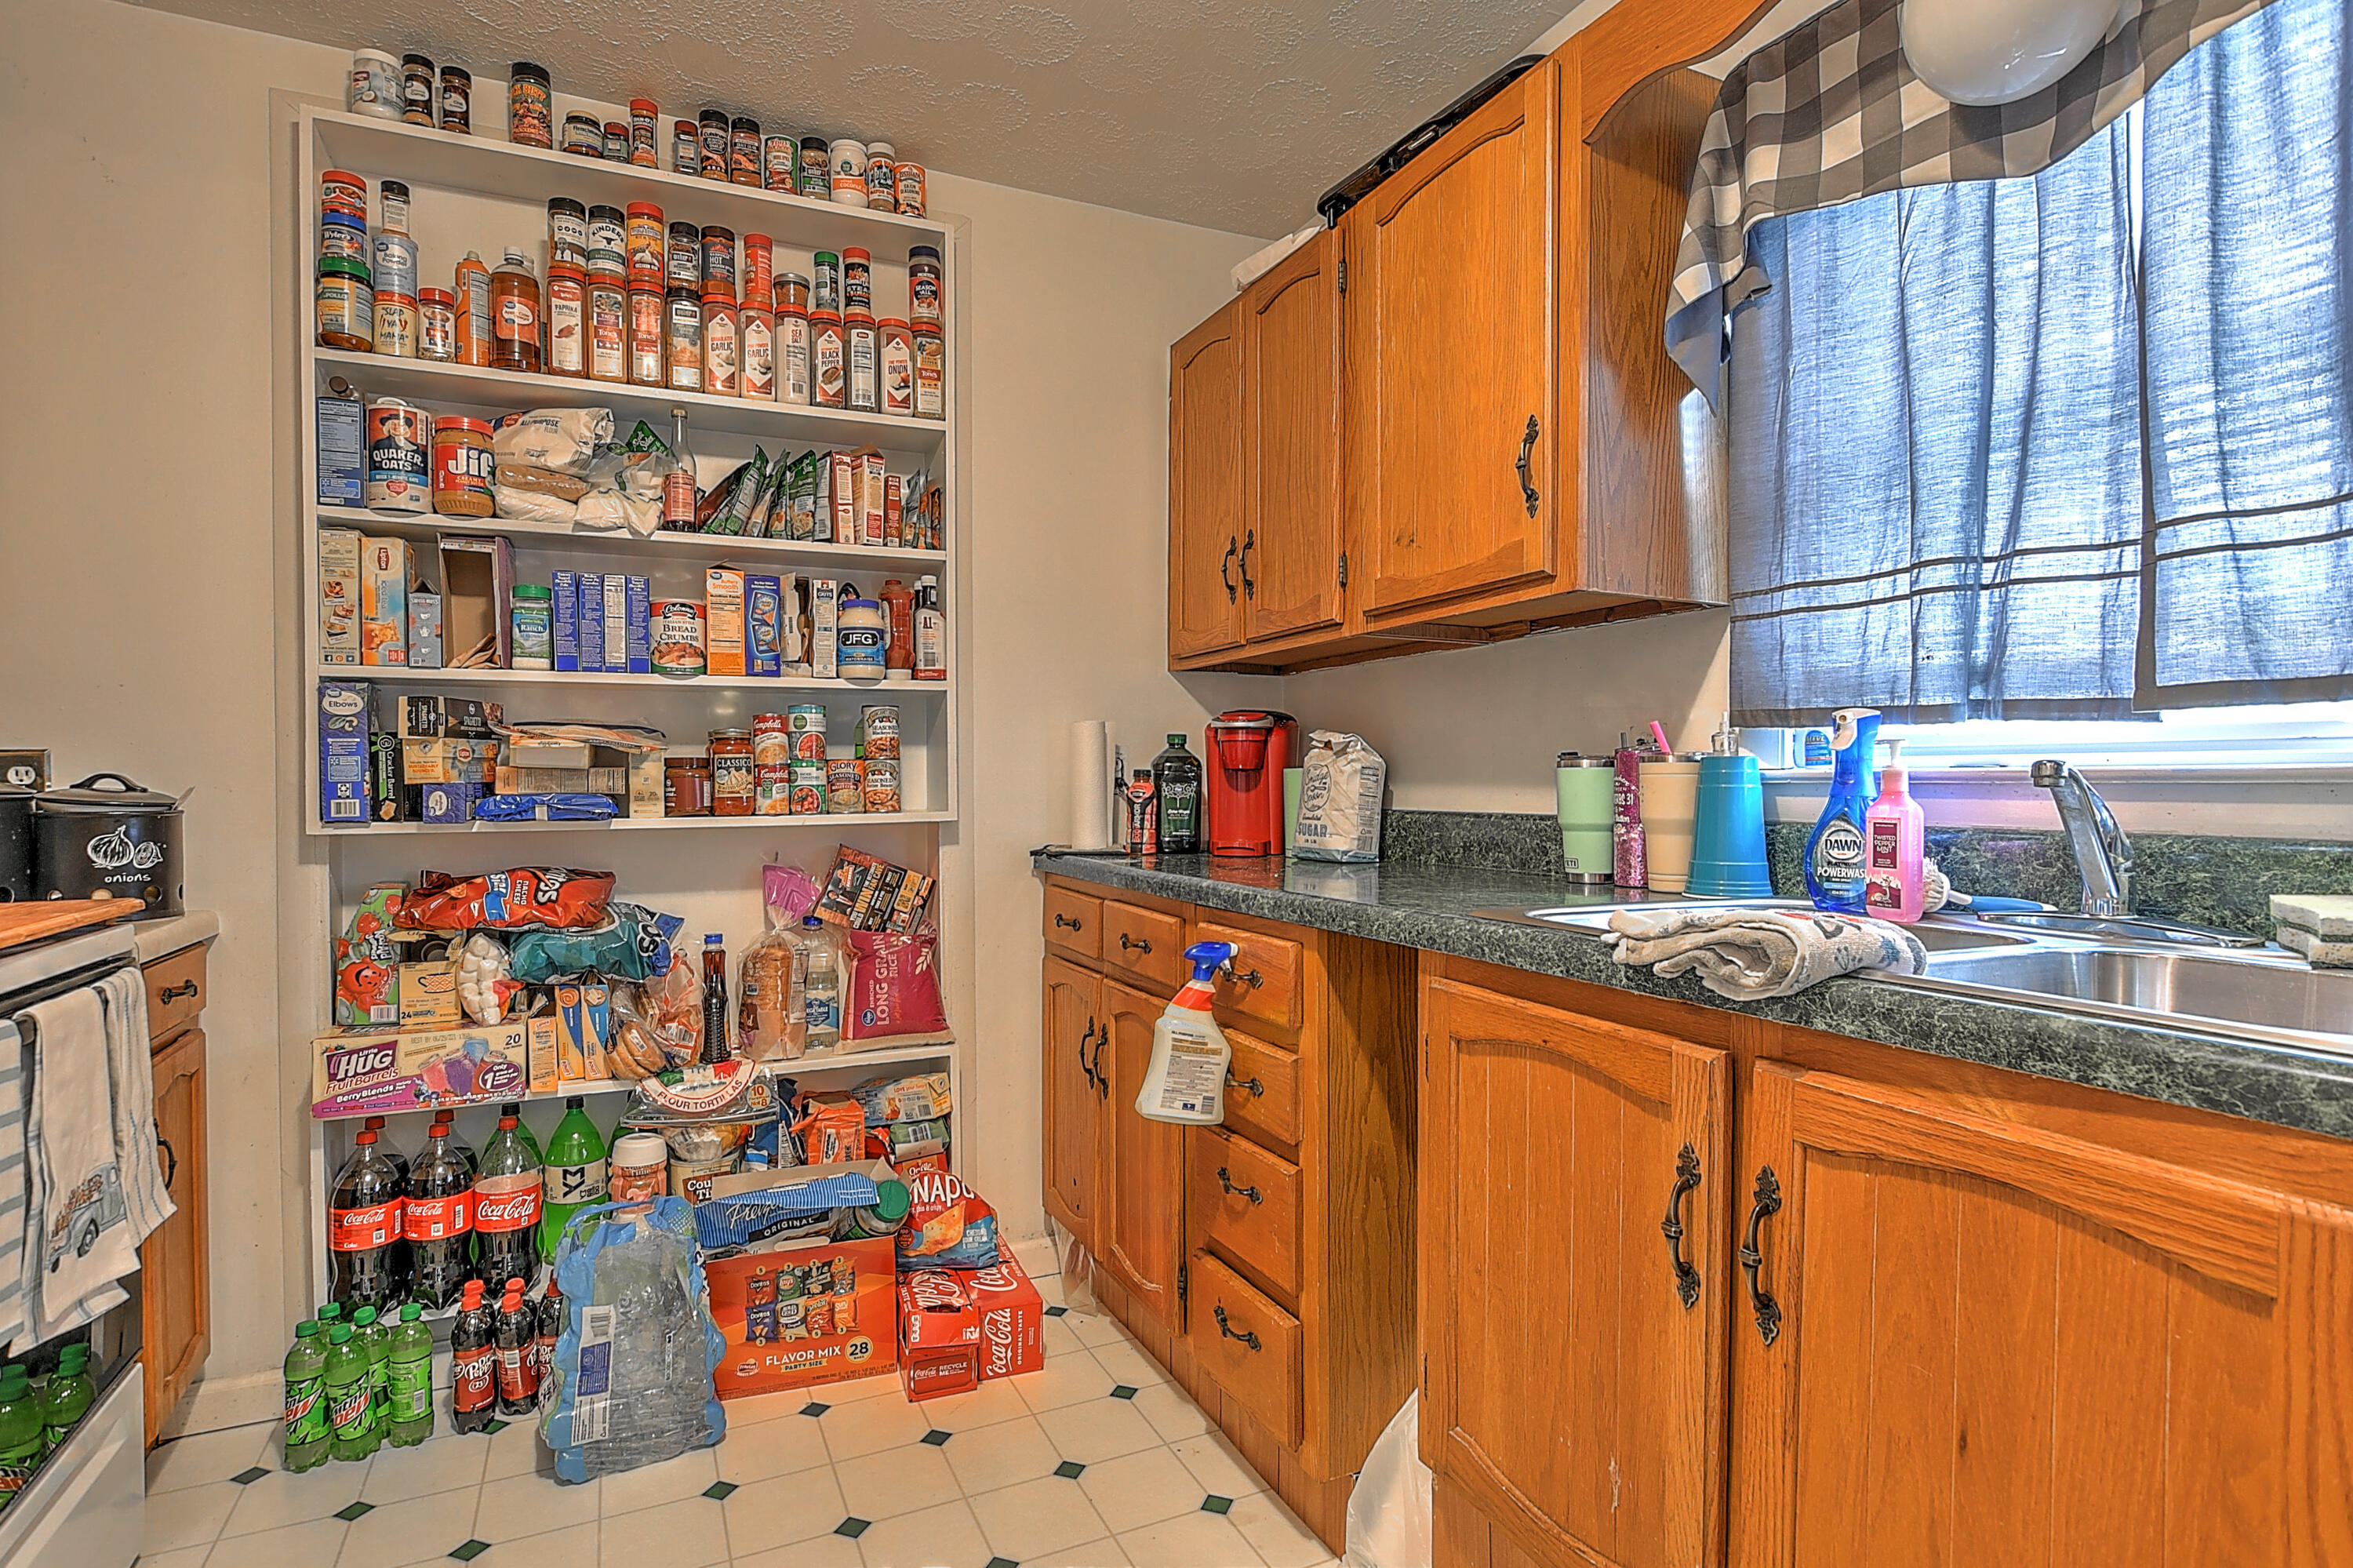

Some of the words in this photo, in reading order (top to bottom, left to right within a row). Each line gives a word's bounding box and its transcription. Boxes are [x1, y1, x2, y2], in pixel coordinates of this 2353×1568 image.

[791, 329, 802, 337] SEA
[821, 351, 840, 359] BLACK
[821, 359, 840, 368] PEPPER
[888, 364, 908, 375] ONION
[373, 449, 424, 467] QUAKER
[381, 458, 413, 471] OATS
[448, 449, 493, 477] Jif
[662, 624, 697, 634] BREAD
[660, 633, 699, 642] CRUMBS
[846, 632, 873, 645] JFG
[329, 700, 358, 709] Elbows
[387, 751, 395, 777] Cracker
[717, 759, 751, 767] CLASSICO
[830, 762, 857, 771] GLORY
[1298, 821, 1329, 838] SUGAR
[1824, 839, 1862, 852] DAWN
[104, 873, 151, 882] onions
[513, 879, 523, 905] CHEESE
[520, 880, 529, 905] NACHO
[853, 888, 873, 913] WIN
[871, 934, 889, 980] GRAIN
[889, 953, 899, 978] RICE
[875, 982, 890, 1025] LONG
[504, 1033, 521, 1046] 20
[359, 1048, 379, 1057] Little
[336, 1050, 393, 1080] HUG
[325, 1079, 355, 1096] Fruit
[355, 1068, 399, 1086] Barrels
[484, 1072, 495, 1090] 1
[336, 1091, 362, 1104] Berry
[362, 1084, 394, 1097] Blends
[751, 1085, 765, 1096] 10
[657, 1090, 690, 1110] FLOUR
[761, 1097, 768, 1107] 8
[407, 1202, 443, 1217] Coca-Cola
[478, 1194, 536, 1222] Coca-Cola
[344, 1208, 385, 1226] Coca-Cola
[764, 1217, 814, 1236] ORIGINAL
[750, 1280, 770, 1289] Doritos
[750, 1311, 770, 1320] Doritos
[966, 1325, 976, 1340] 12
[849, 1341, 869, 1357] 28
[984, 1308, 1013, 1377] Coca-Cola
[766, 1350, 815, 1366] FLAVOR
[818, 1345, 842, 1357] MIX
[784, 1362, 807, 1371] PARTY
[939, 1361, 968, 1370] RECYCLE
